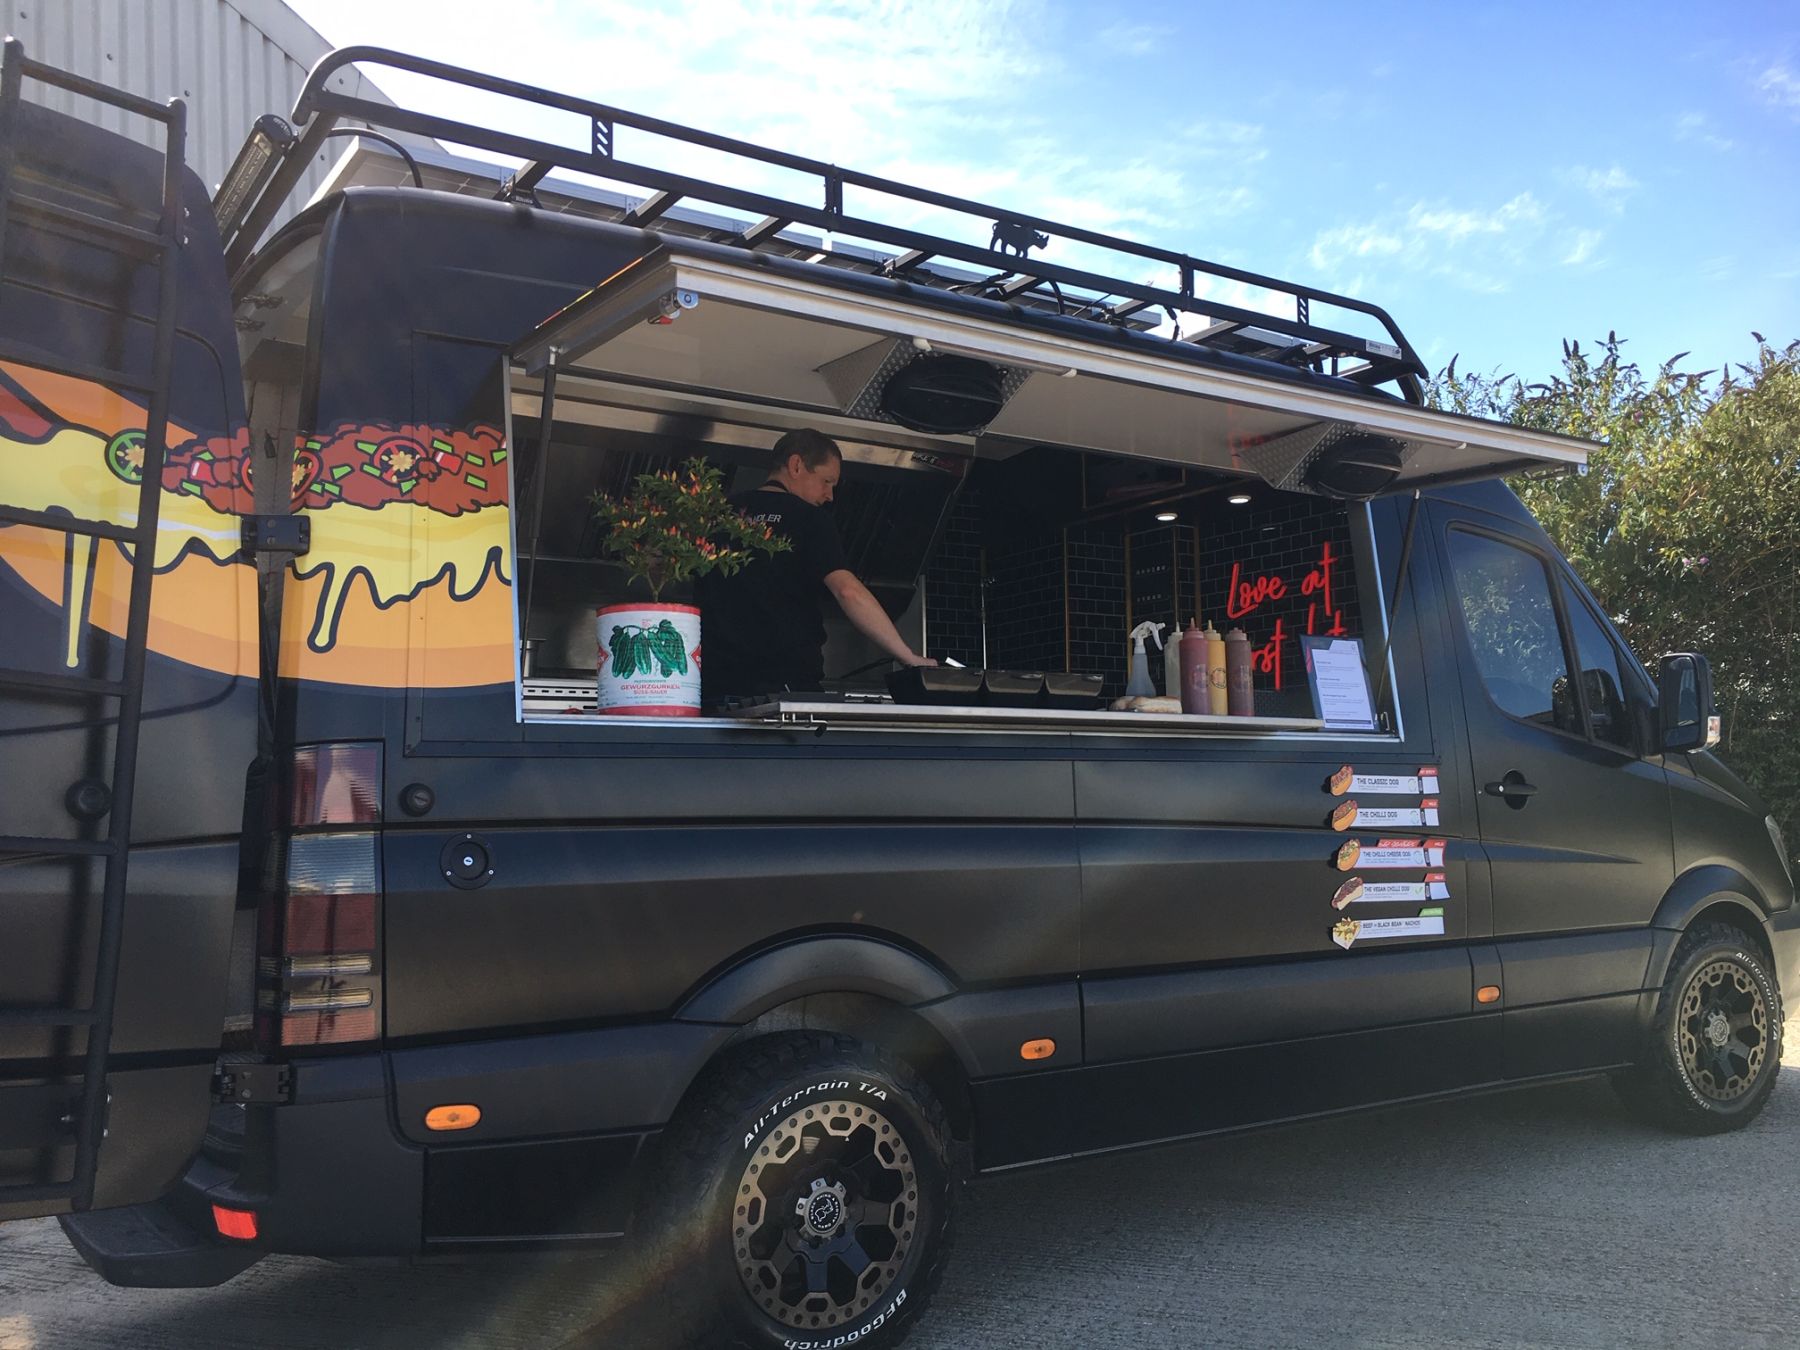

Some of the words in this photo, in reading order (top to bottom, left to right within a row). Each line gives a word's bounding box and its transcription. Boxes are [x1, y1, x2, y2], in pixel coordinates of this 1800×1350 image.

[1227, 562, 1287, 619] Love
[1301, 540, 1338, 616] at
[1250, 618, 1287, 692] rst
[1357, 777, 1367, 785] THE
[1389, 778, 1400, 786] DOG
[744, 1079, 850, 1149] All-Terrain
[859, 1081, 889, 1101] T/A
[784, 1288, 908, 1350] BFGoodrich
